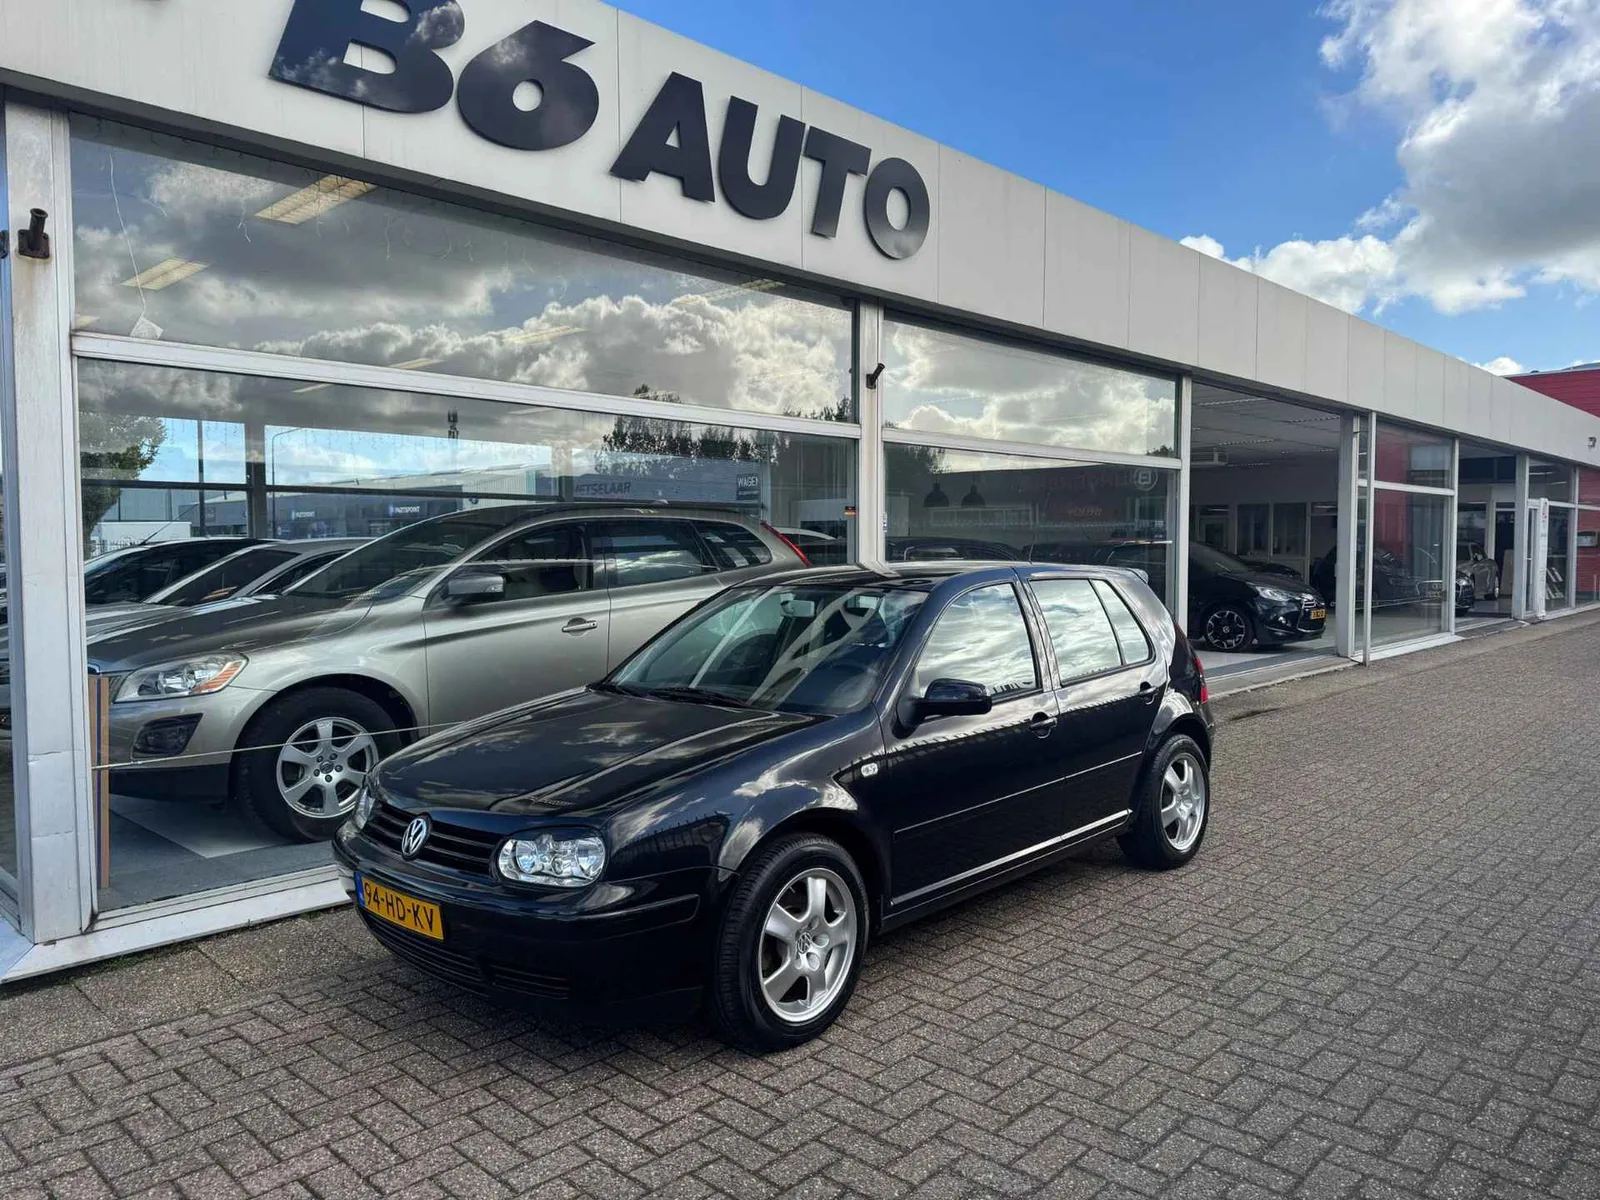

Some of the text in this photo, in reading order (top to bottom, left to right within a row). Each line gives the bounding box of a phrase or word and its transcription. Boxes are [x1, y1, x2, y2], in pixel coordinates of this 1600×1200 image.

[269, 0, 930, 260] B6 AUTO
[364, 882, 434, 932] 94-HD-KV
